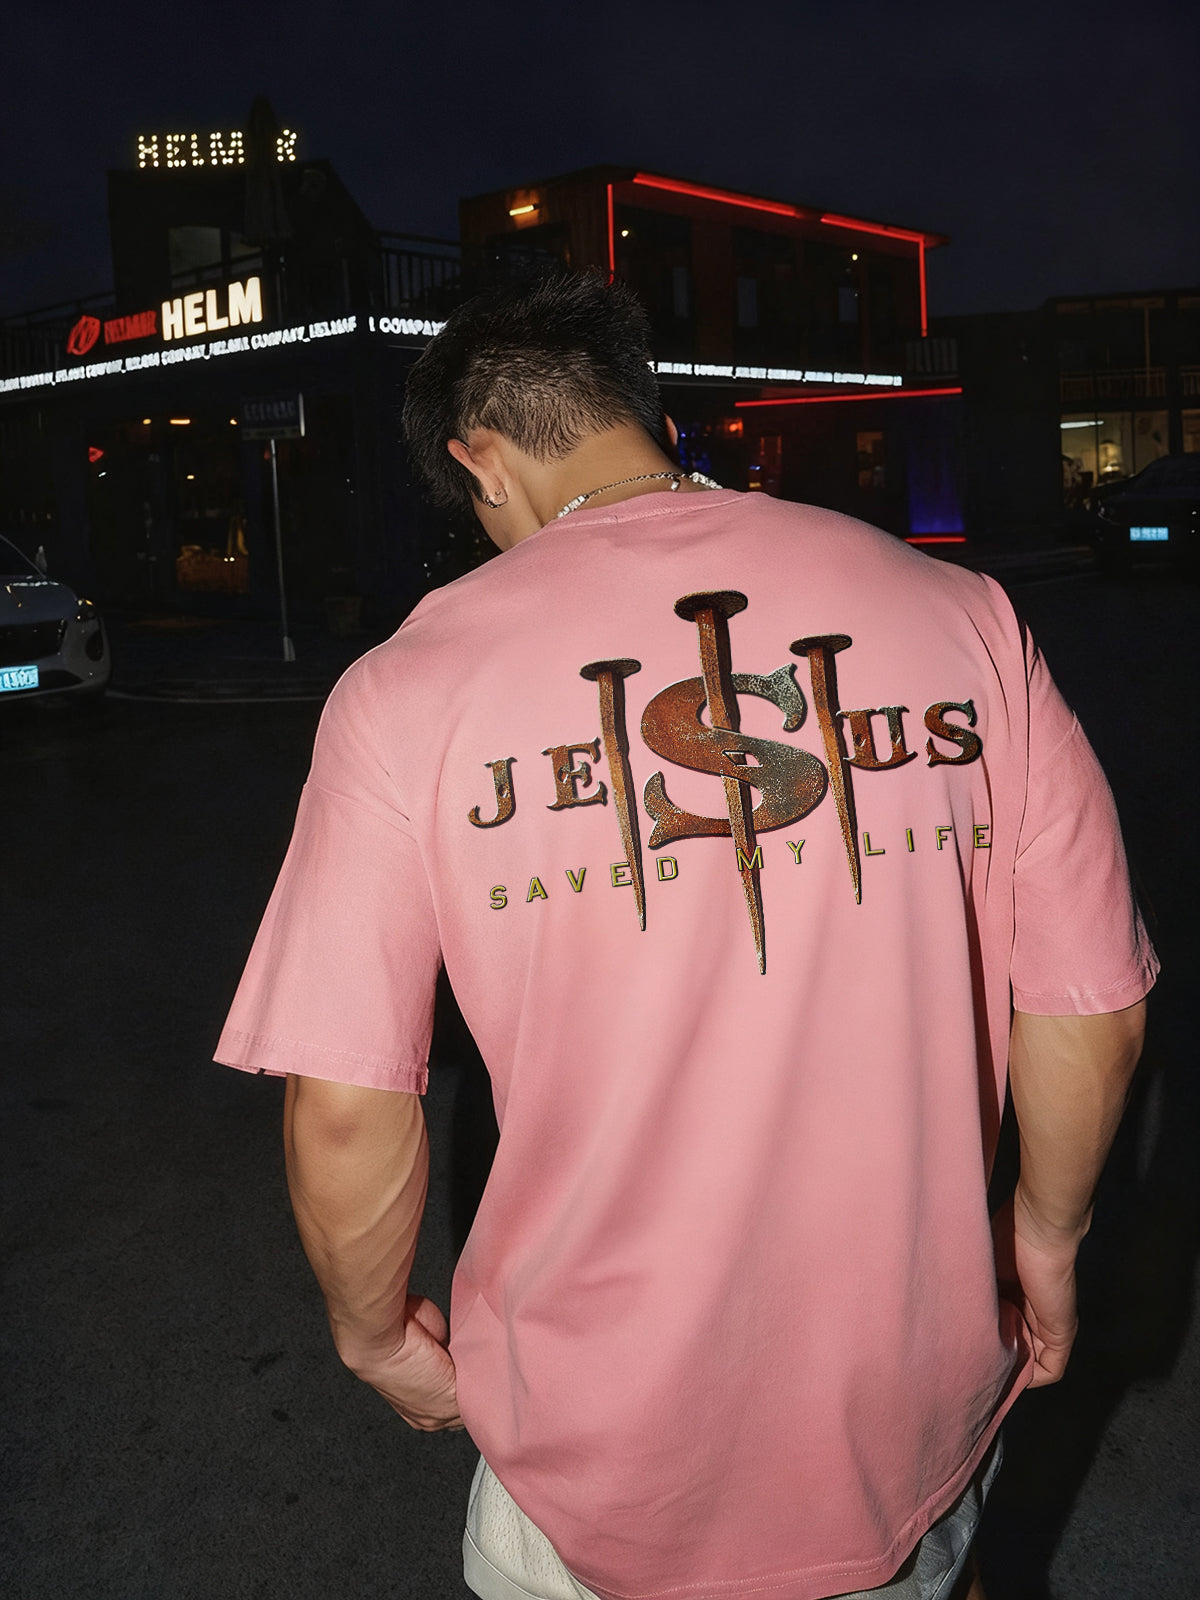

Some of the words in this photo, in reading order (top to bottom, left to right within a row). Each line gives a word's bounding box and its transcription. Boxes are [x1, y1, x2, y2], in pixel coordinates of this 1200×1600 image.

[161, 276, 263, 341] HELM
[467, 662, 984, 849] JESUS
[489, 855, 679, 910] SAVED
[736, 838, 806, 873] MY
[863, 823, 991, 857] LIFE
